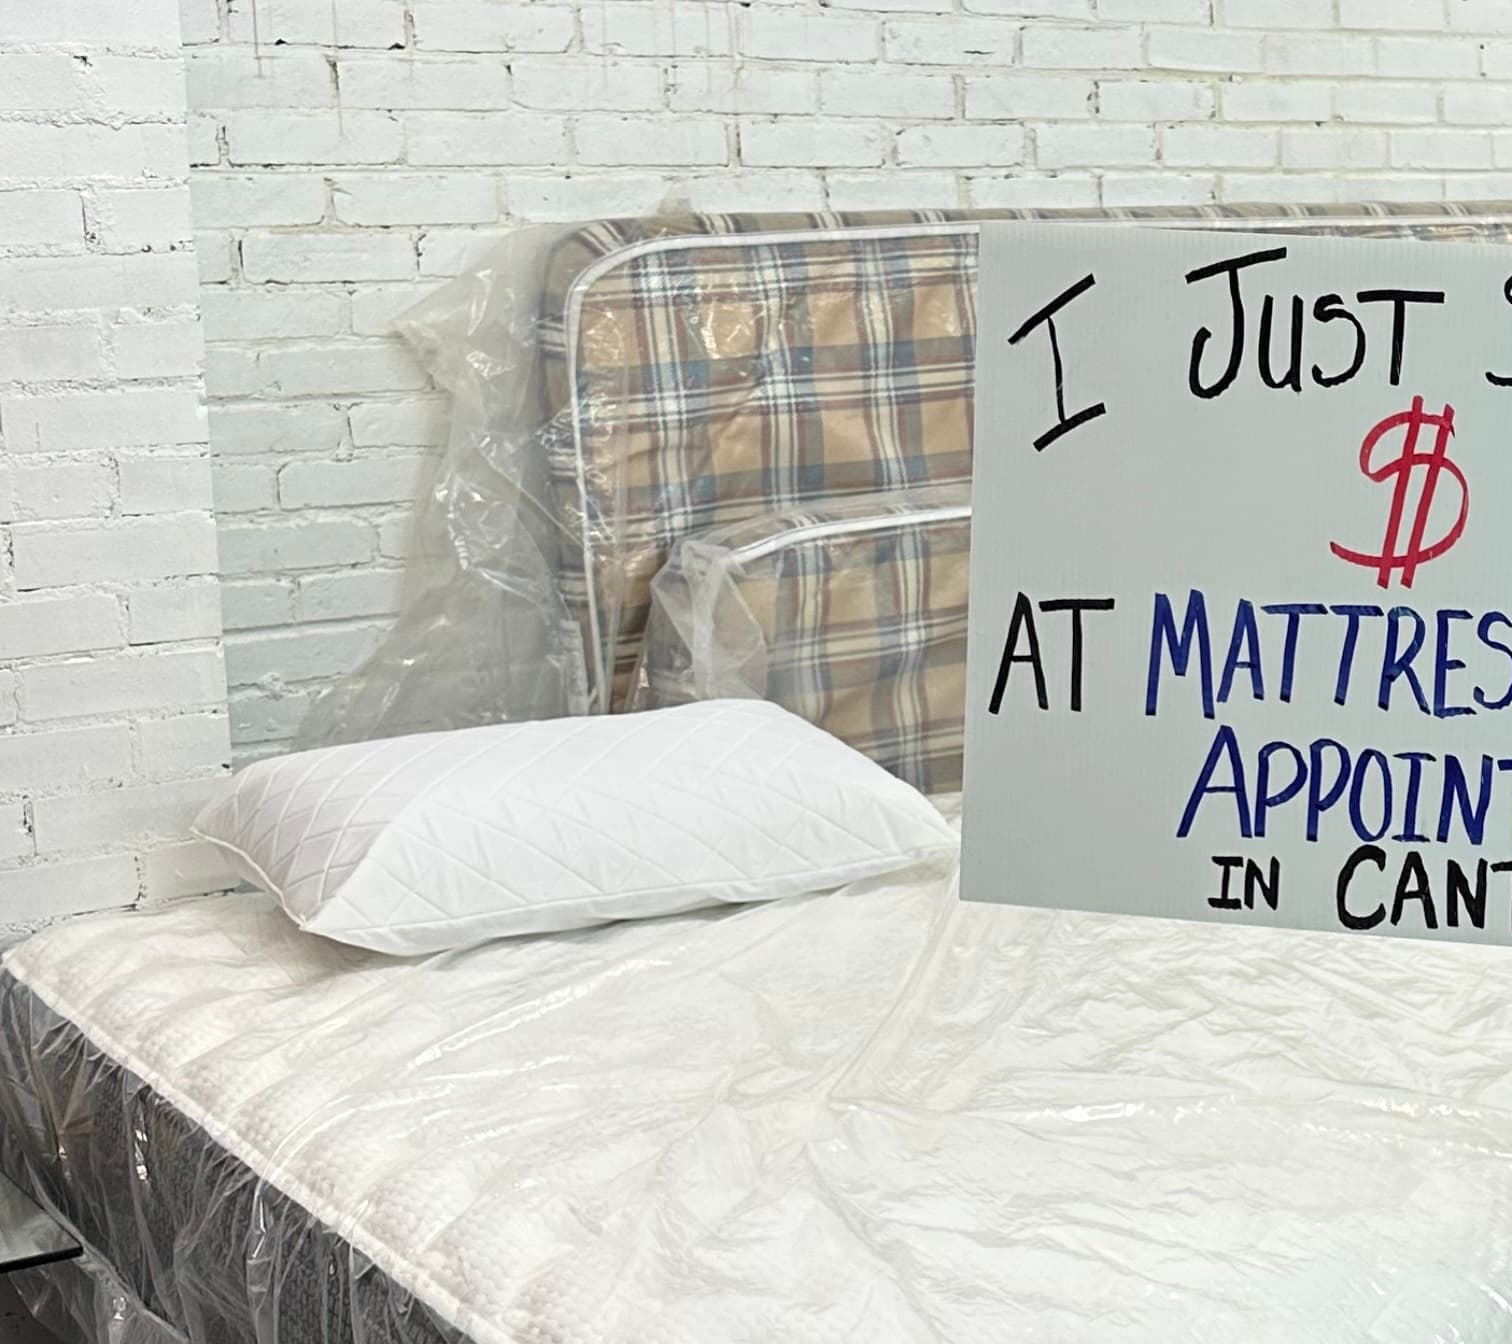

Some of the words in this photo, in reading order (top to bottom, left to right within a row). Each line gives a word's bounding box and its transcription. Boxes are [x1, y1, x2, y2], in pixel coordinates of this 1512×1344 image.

[1008, 274, 1106, 452] I
[1185, 247, 1444, 399] JUST
[1330, 396, 1468, 589] $
[989, 591, 1114, 715] AT
[1208, 855, 1281, 911] IN
